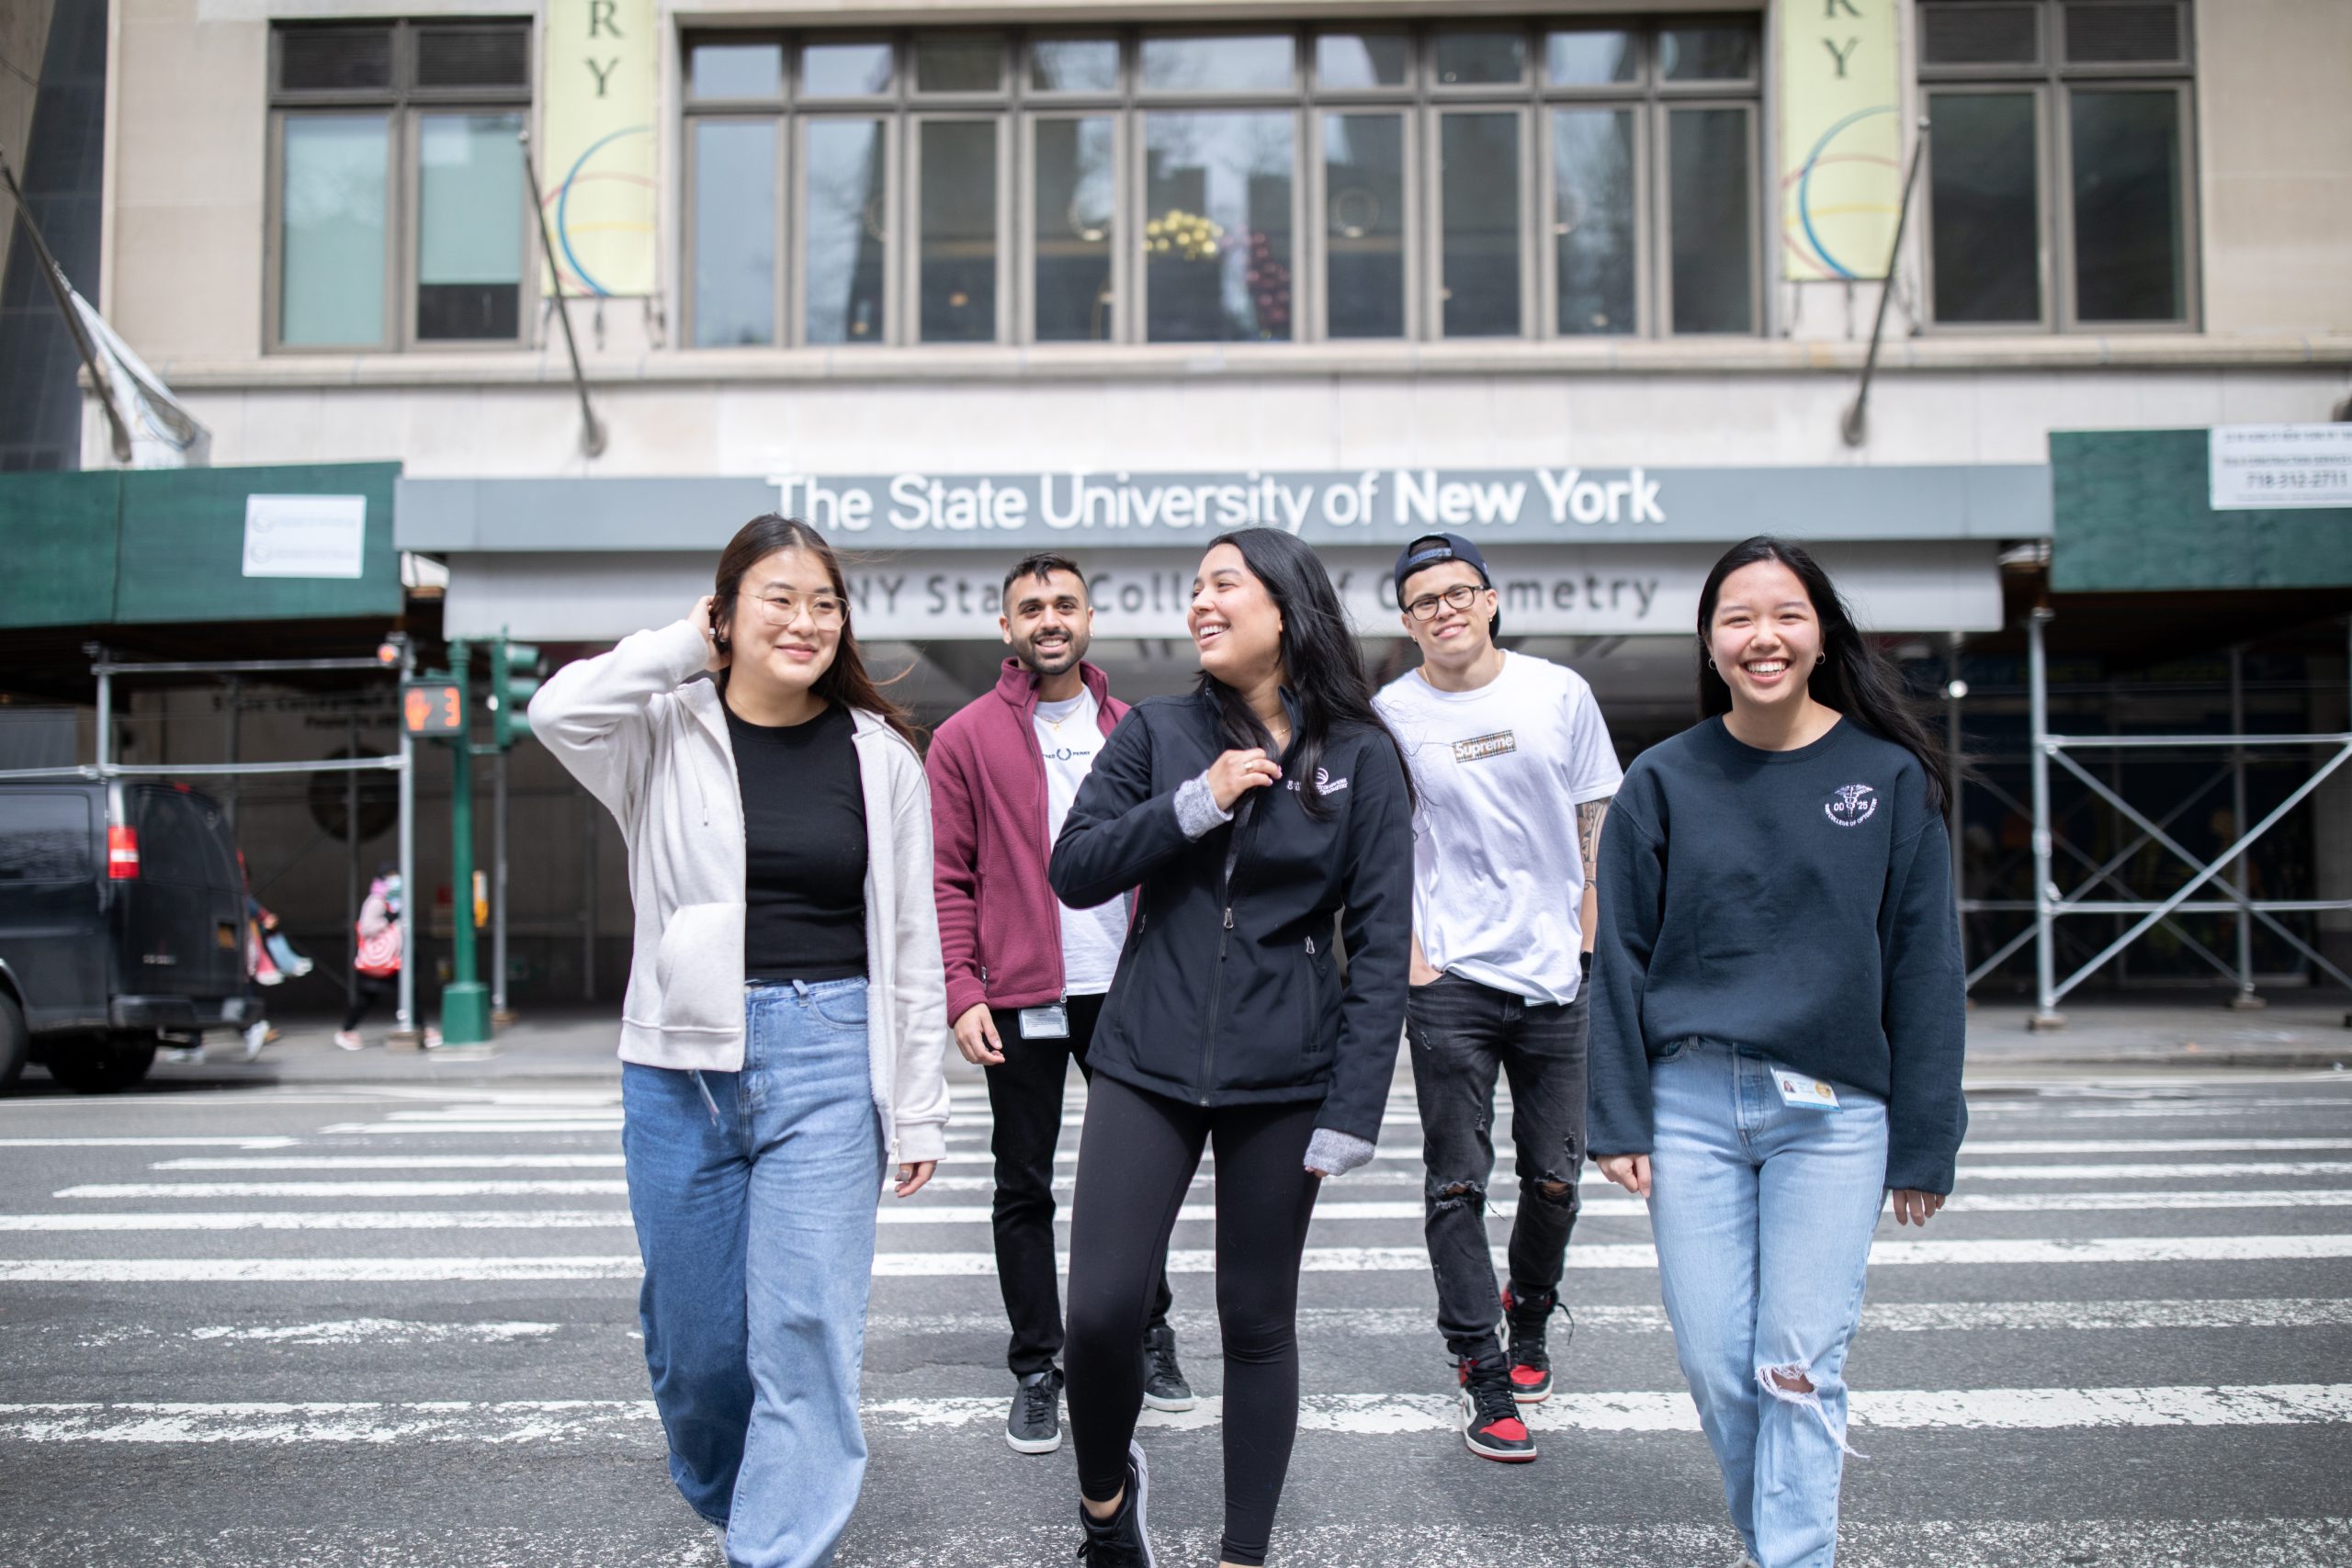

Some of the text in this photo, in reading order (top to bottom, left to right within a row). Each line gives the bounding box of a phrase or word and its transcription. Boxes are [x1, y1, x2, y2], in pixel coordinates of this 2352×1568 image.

[766, 467, 1666, 536] The State University of New York
[846, 573, 905, 614] NY
[925, 573, 1002, 615] Sta
[1088, 571, 1183, 613] Coll
[444, 687, 460, 727] 3
[1455, 736, 1514, 760] Supreme
[1828, 814, 1849, 826] COLLEGE
